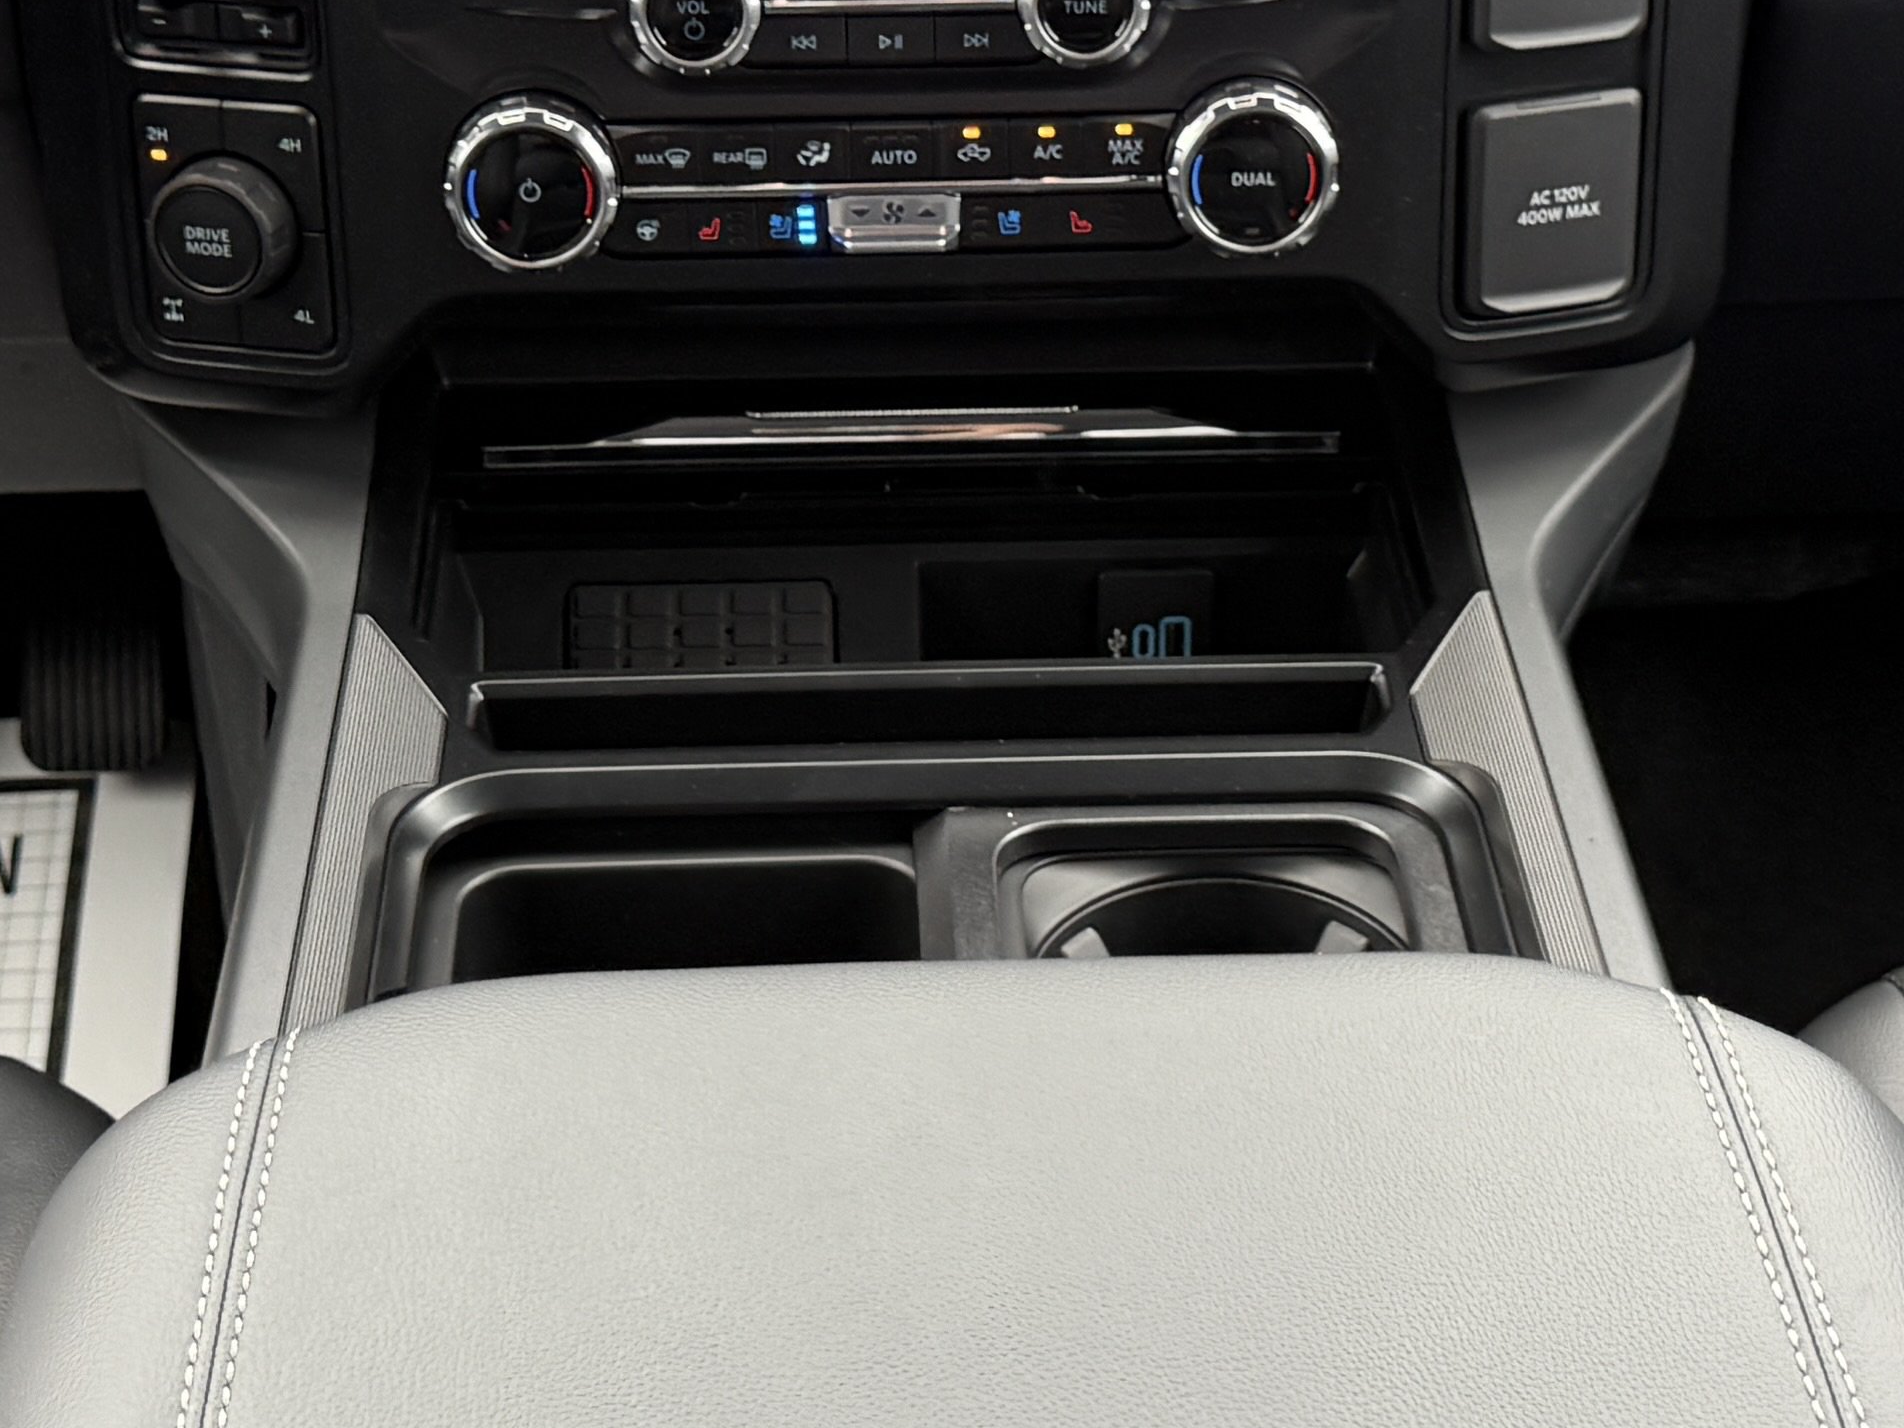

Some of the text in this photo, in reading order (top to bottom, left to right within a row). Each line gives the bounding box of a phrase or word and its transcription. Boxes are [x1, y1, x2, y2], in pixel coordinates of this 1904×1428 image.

[676, 0, 710, 15] VOL
[1064, 0, 1108, 15] TUNE
[146, 126, 169, 142] 2H
[278, 137, 302, 153] 4H
[1033, 144, 1063, 161] A/C
[1108, 140, 1144, 154] MAX
[635, 153, 664, 166] MAX
[713, 150, 743, 165] REAR
[871, 149, 918, 165] AUTO
[1112, 150, 1140, 166] A/C
[1231, 171, 1276, 187] DUAL
[1529, 185, 1591, 206] AC 120V
[1517, 201, 1601, 226] 400W MAX
[184, 225, 231, 243] DRIVE
[185, 241, 233, 258] MODE
[294, 309, 315, 325] 4L
